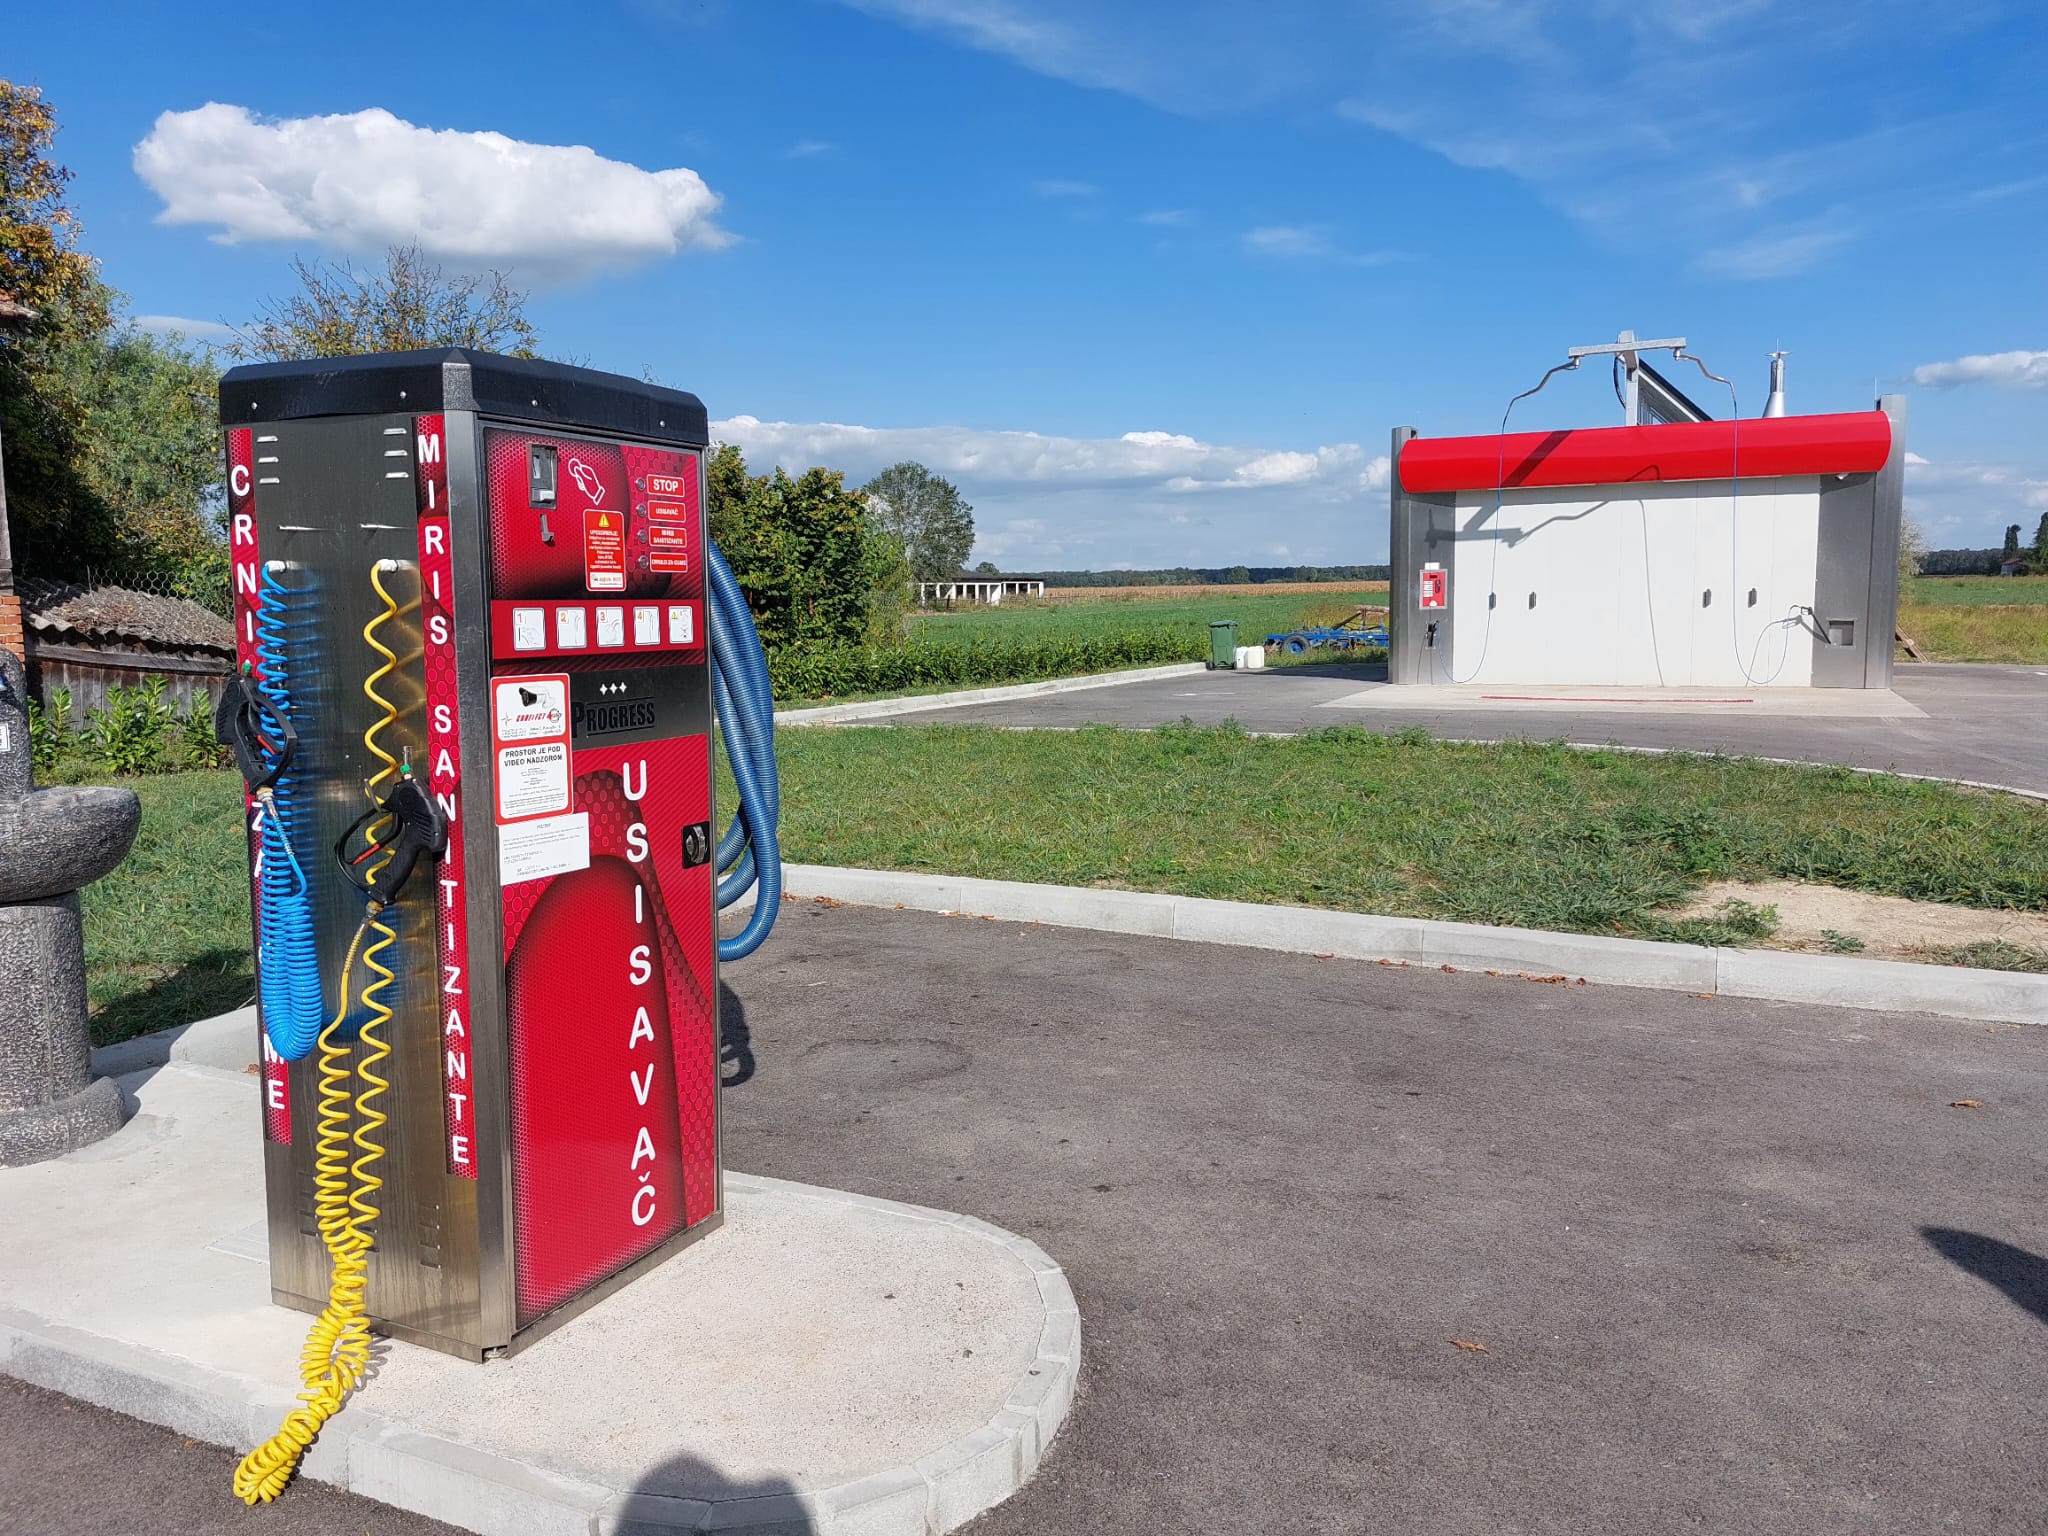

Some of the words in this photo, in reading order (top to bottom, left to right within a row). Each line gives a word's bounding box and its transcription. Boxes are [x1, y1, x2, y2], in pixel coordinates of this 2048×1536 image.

[653, 478, 679, 492] STOP
[417, 433, 448, 645] MIRIS
[517, 612, 524, 623] 1
[560, 612, 567, 623] 2
[600, 611, 606, 621] 3
[637, 610, 644, 620] 4
[571, 701, 656, 738] PROGRESS
[505, 748, 537, 758] PROSTOR
[538, 746, 546, 754] JE
[547, 745, 561, 753] POD
[504, 758, 525, 767] VIDEO
[526, 754, 563, 765] NADZOROM
[622, 759, 656, 1227] USISAVAČ
